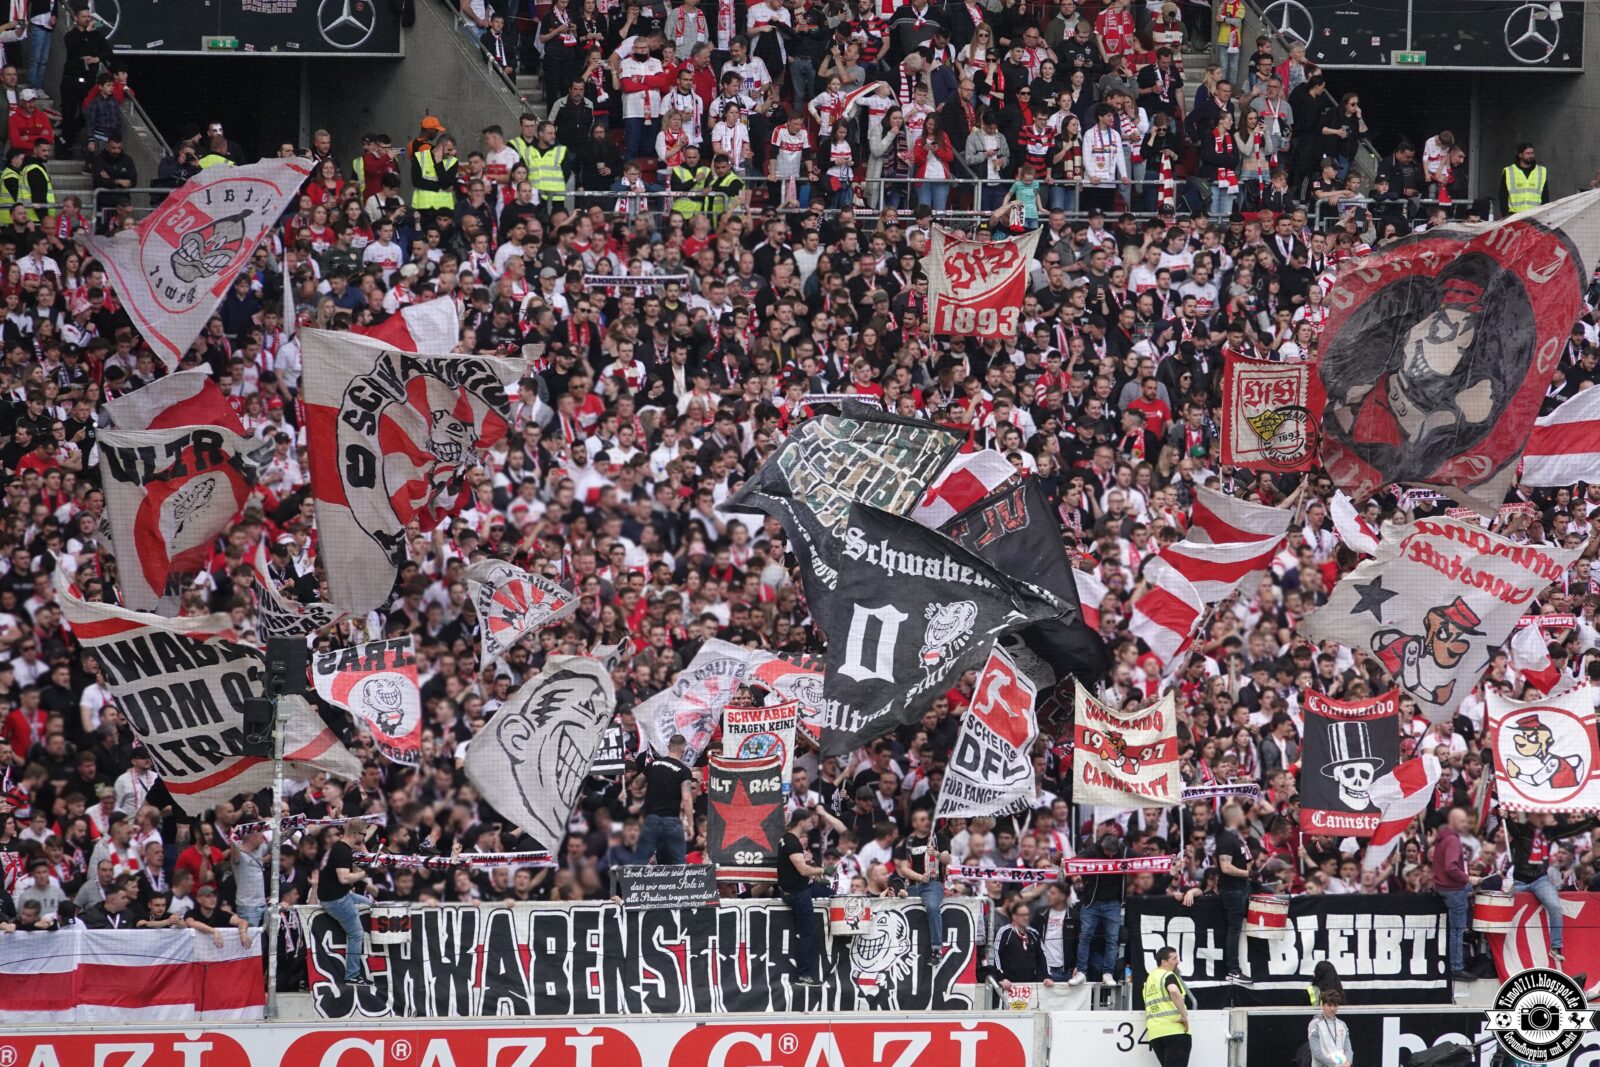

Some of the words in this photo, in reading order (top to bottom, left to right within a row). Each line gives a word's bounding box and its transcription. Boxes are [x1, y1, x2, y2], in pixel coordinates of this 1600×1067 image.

[940, 304, 1019, 336] 1893
[1279, 430, 1301, 443] 1893
[727, 705, 797, 724] SCHWABEN
[1085, 698, 1164, 733] COMMANDO
[1308, 694, 1395, 717] Commando
[728, 722, 766, 735] TRAGEN
[955, 732, 1027, 782] DFL
[710, 776, 733, 793] ULT
[750, 776, 781, 795] RAS
[942, 775, 963, 797] FÜR
[1083, 761, 1170, 797] CANNSTATT
[1311, 810, 1380, 829] Cannsta
[961, 867, 994, 878] ULT
[1011, 871, 1046, 881] RAS
[1264, 912, 1448, 978] BLEIBT!
